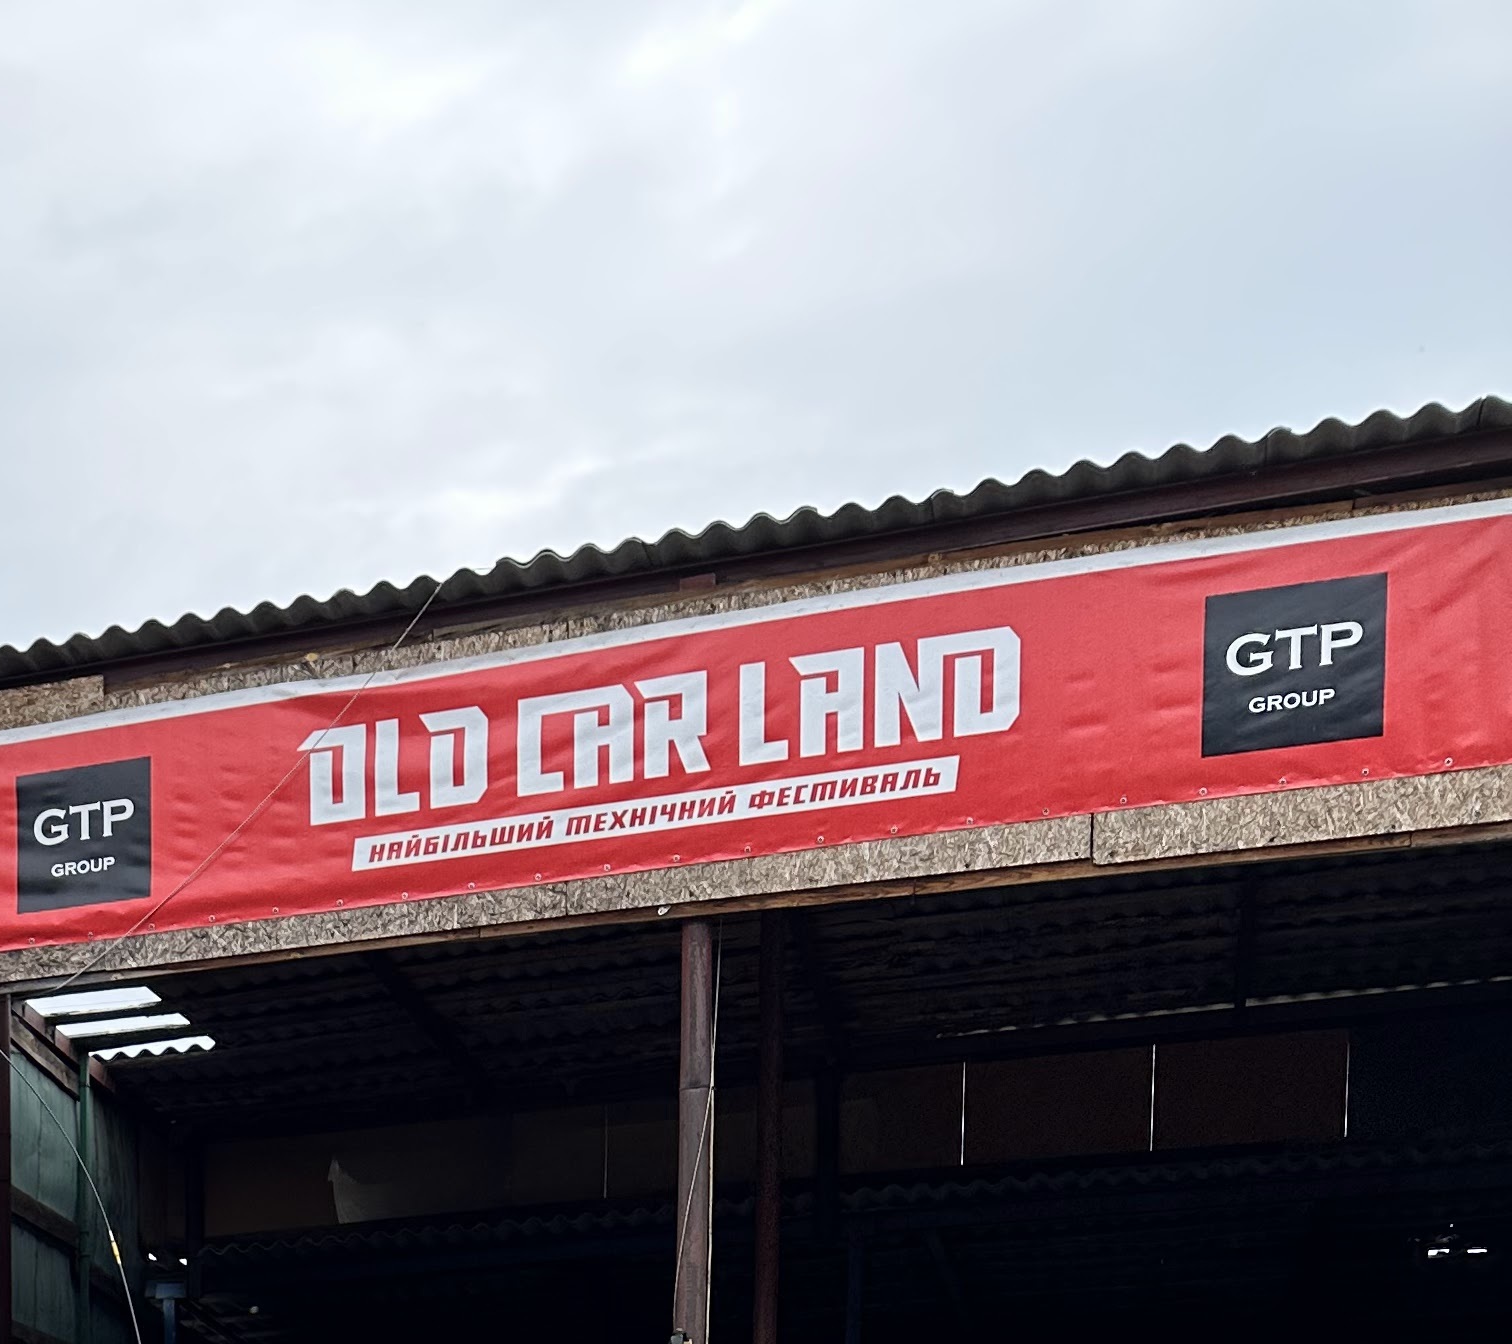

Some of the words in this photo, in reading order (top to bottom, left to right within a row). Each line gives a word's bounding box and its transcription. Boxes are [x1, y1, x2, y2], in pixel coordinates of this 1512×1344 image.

[1226, 621, 1364, 676] GTP
[297, 706, 488, 826] OLD
[517, 671, 711, 798] CAR
[738, 626, 1022, 767] LAND
[1248, 688, 1336, 713] GROUP
[33, 798, 135, 846] GTP
[368, 815, 554, 865] НАЙБІЛЬШИЙ
[566, 789, 736, 836] ТЕХНІЧНИЙ
[749, 767, 943, 812] ФЕСТИВАЛЬ
[50, 856, 116, 878] GROUP
